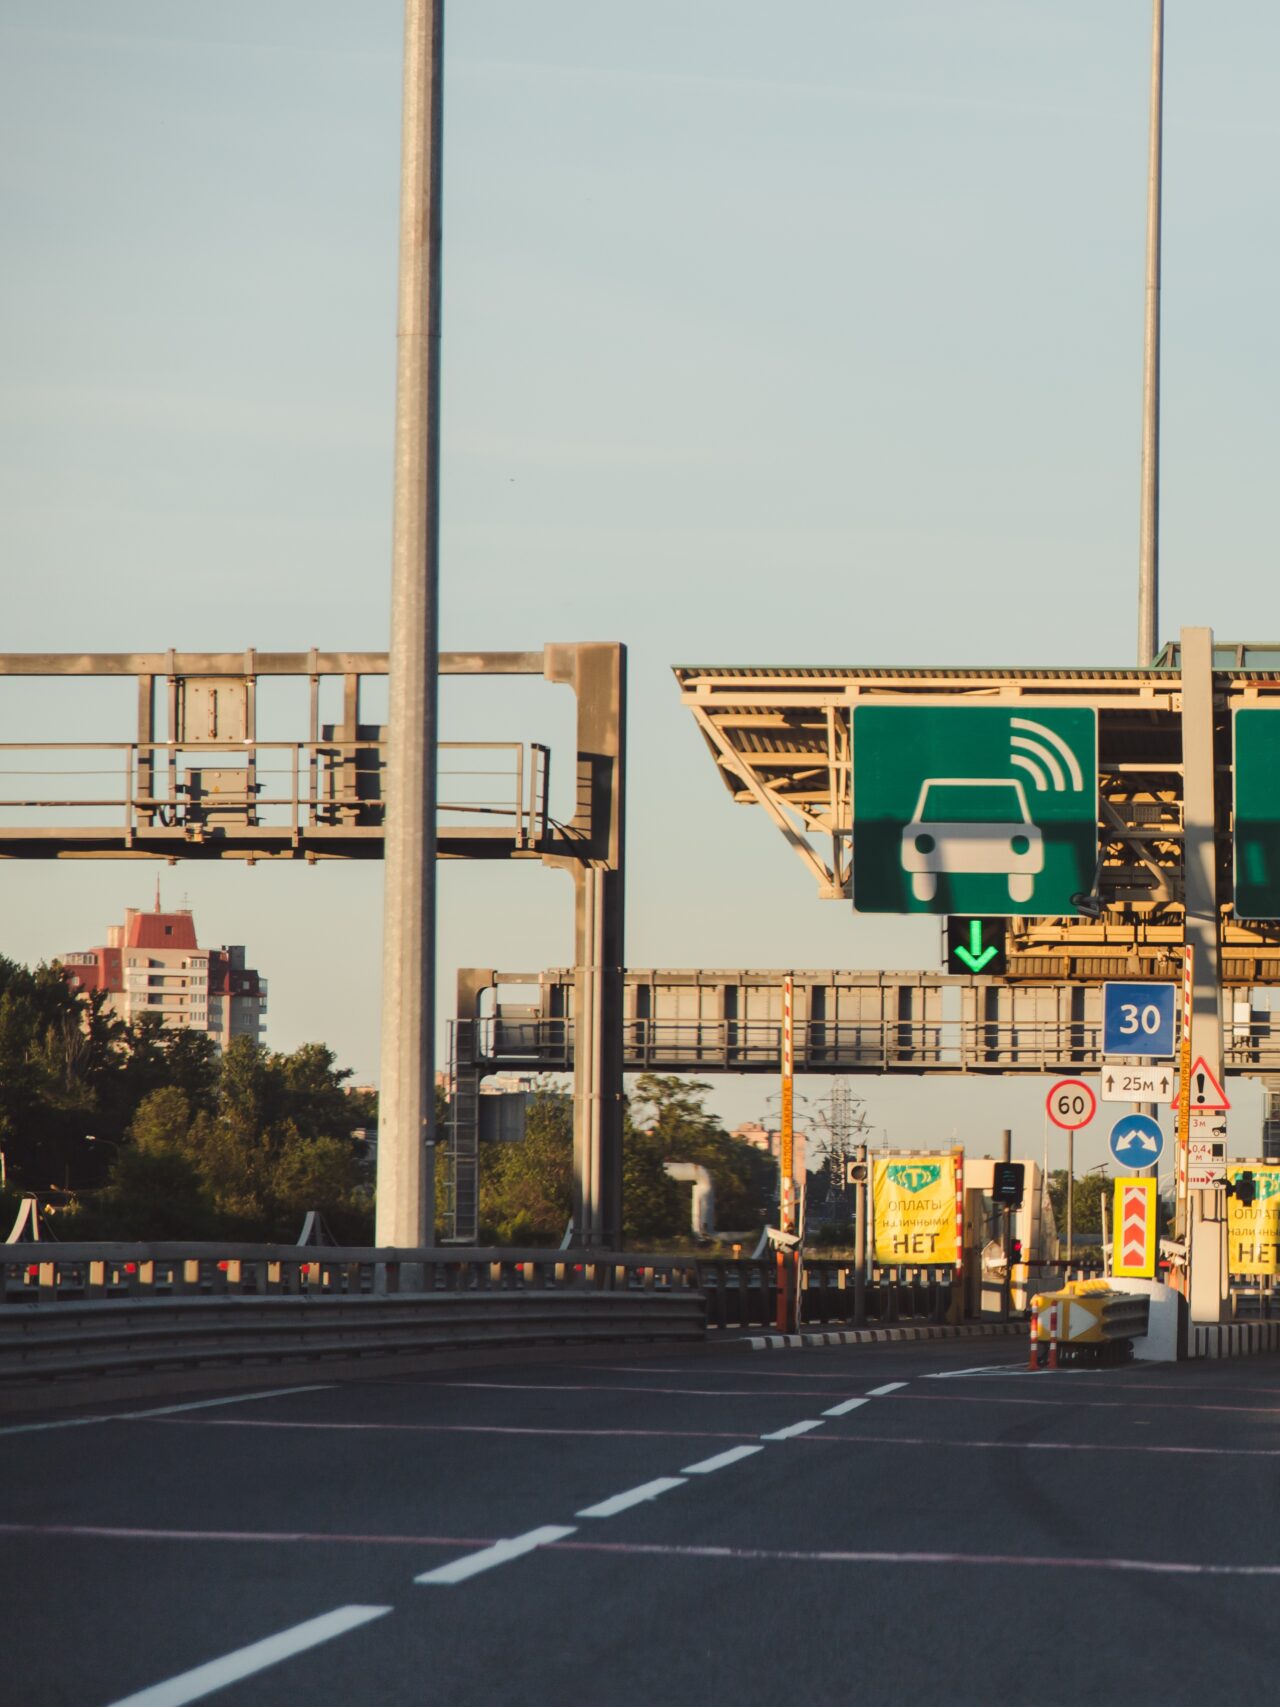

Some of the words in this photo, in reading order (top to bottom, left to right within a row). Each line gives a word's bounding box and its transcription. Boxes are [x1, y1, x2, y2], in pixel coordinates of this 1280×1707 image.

[1119, 1004, 1161, 1034] 30
[1181, 1050, 1191, 1092] ЗАКРЫТА
[1122, 1077, 1154, 1091] 25м
[1058, 1096, 1085, 1115] 60
[1181, 1096, 1189, 1133] ПОЛОСА
[1192, 1145, 1206, 1154] 0,4
[889, 1199, 942, 1211] ОПЛАТЫ
[893, 1233, 940, 1254] НЕТ
